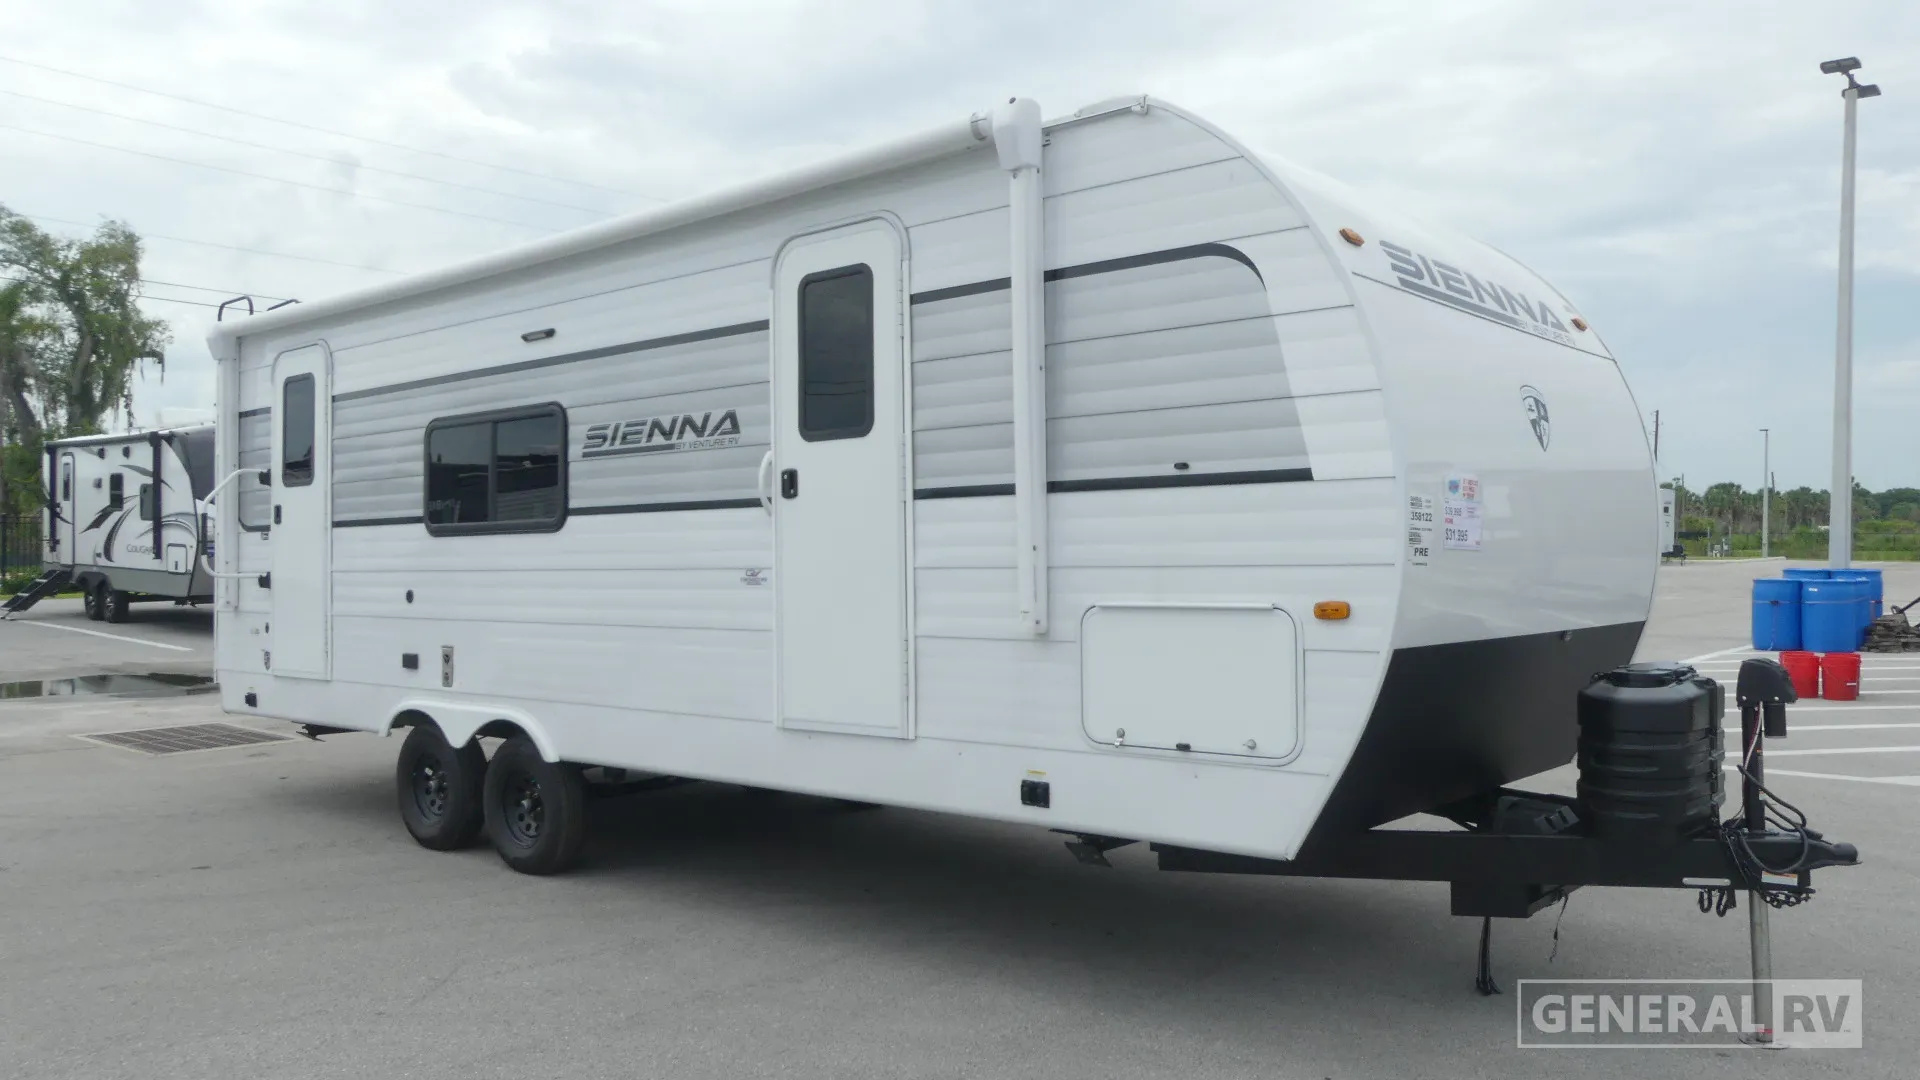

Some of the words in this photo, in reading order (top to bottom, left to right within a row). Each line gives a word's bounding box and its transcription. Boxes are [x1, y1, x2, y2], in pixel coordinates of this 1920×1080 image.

[1379, 240, 1570, 334] SIENNA
[582, 409, 741, 449] SIENNA
[689, 438, 727, 449] VENTURE
[728, 436, 740, 446] RV
[1410, 511, 1433, 522] 358122
[1414, 547, 1429, 557] PRE
